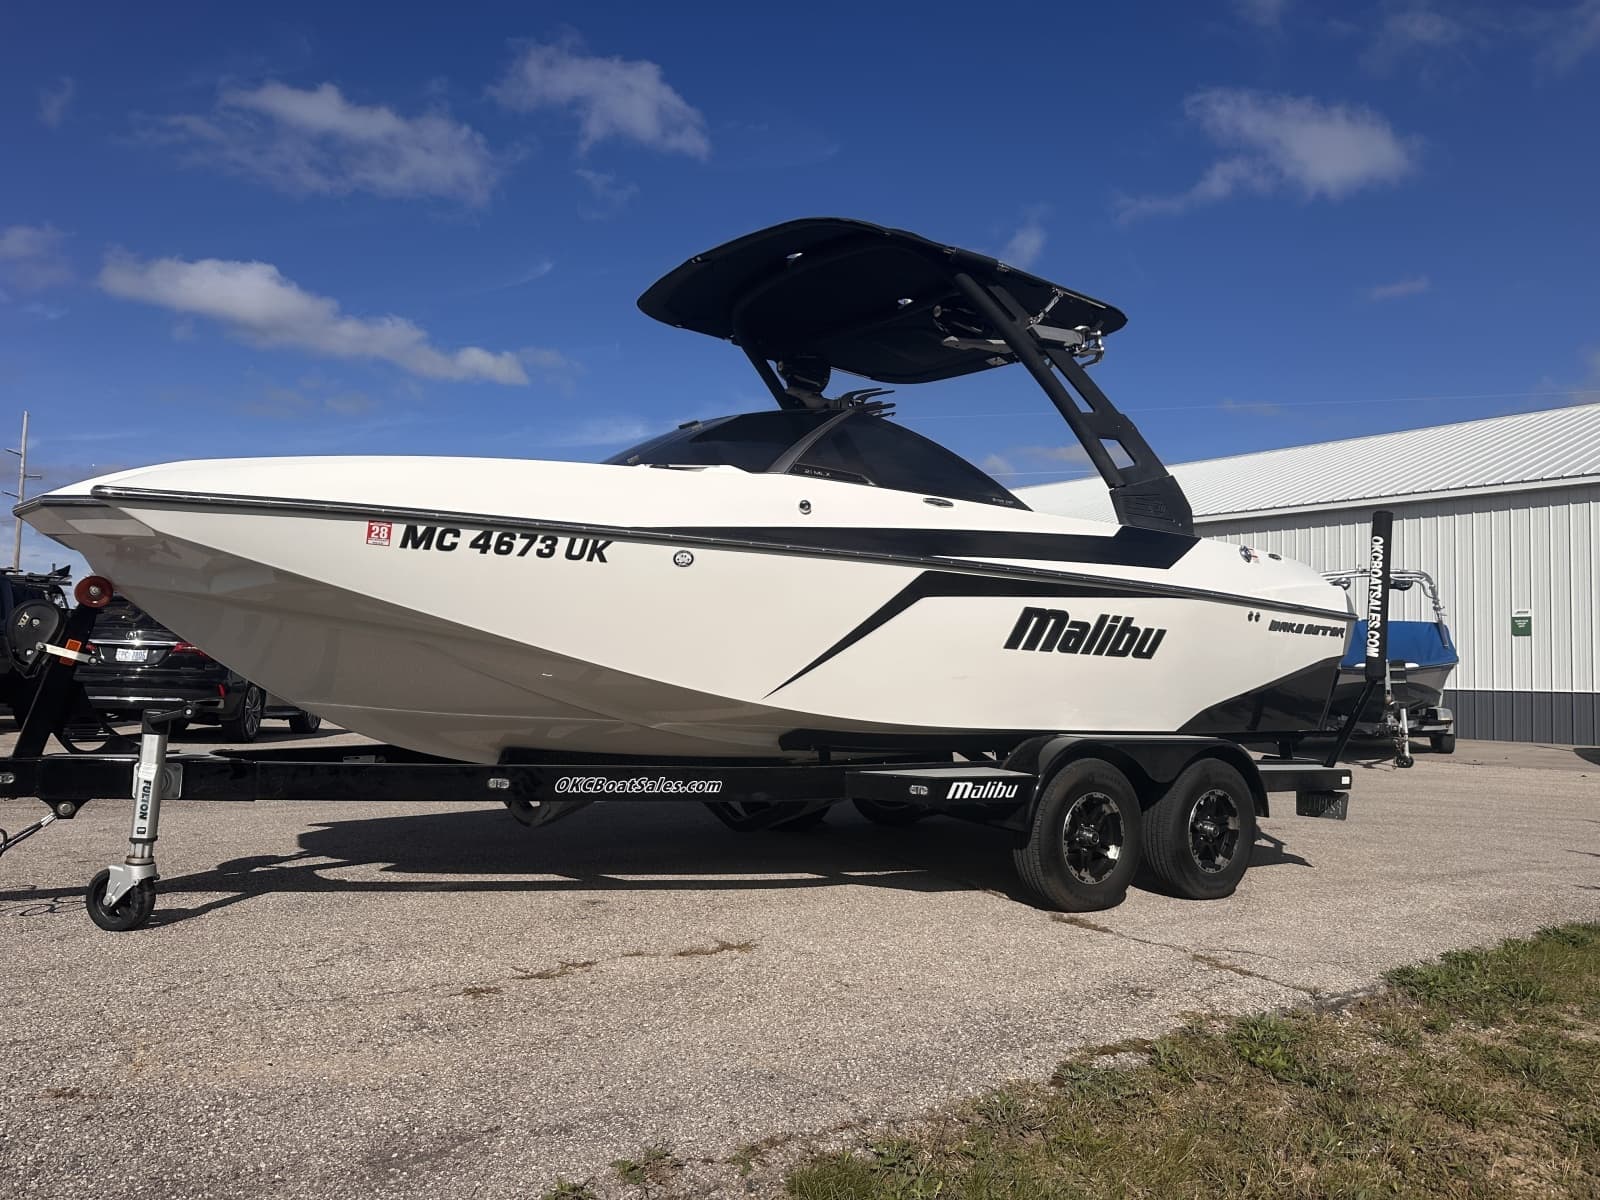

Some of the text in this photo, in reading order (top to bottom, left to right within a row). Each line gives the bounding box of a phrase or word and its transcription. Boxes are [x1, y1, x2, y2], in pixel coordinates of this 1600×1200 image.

[370, 525, 388, 539] 28
[399, 524, 613, 563] MC 4673 UK
[1366, 535, 1384, 658] OKCBOATSALES.COM
[1003, 606, 1167, 660] Malibu
[138, 780, 152, 820] FULTON
[554, 776, 723, 793] OKCBoatSales.com
[945, 781, 1019, 800] Malibu
